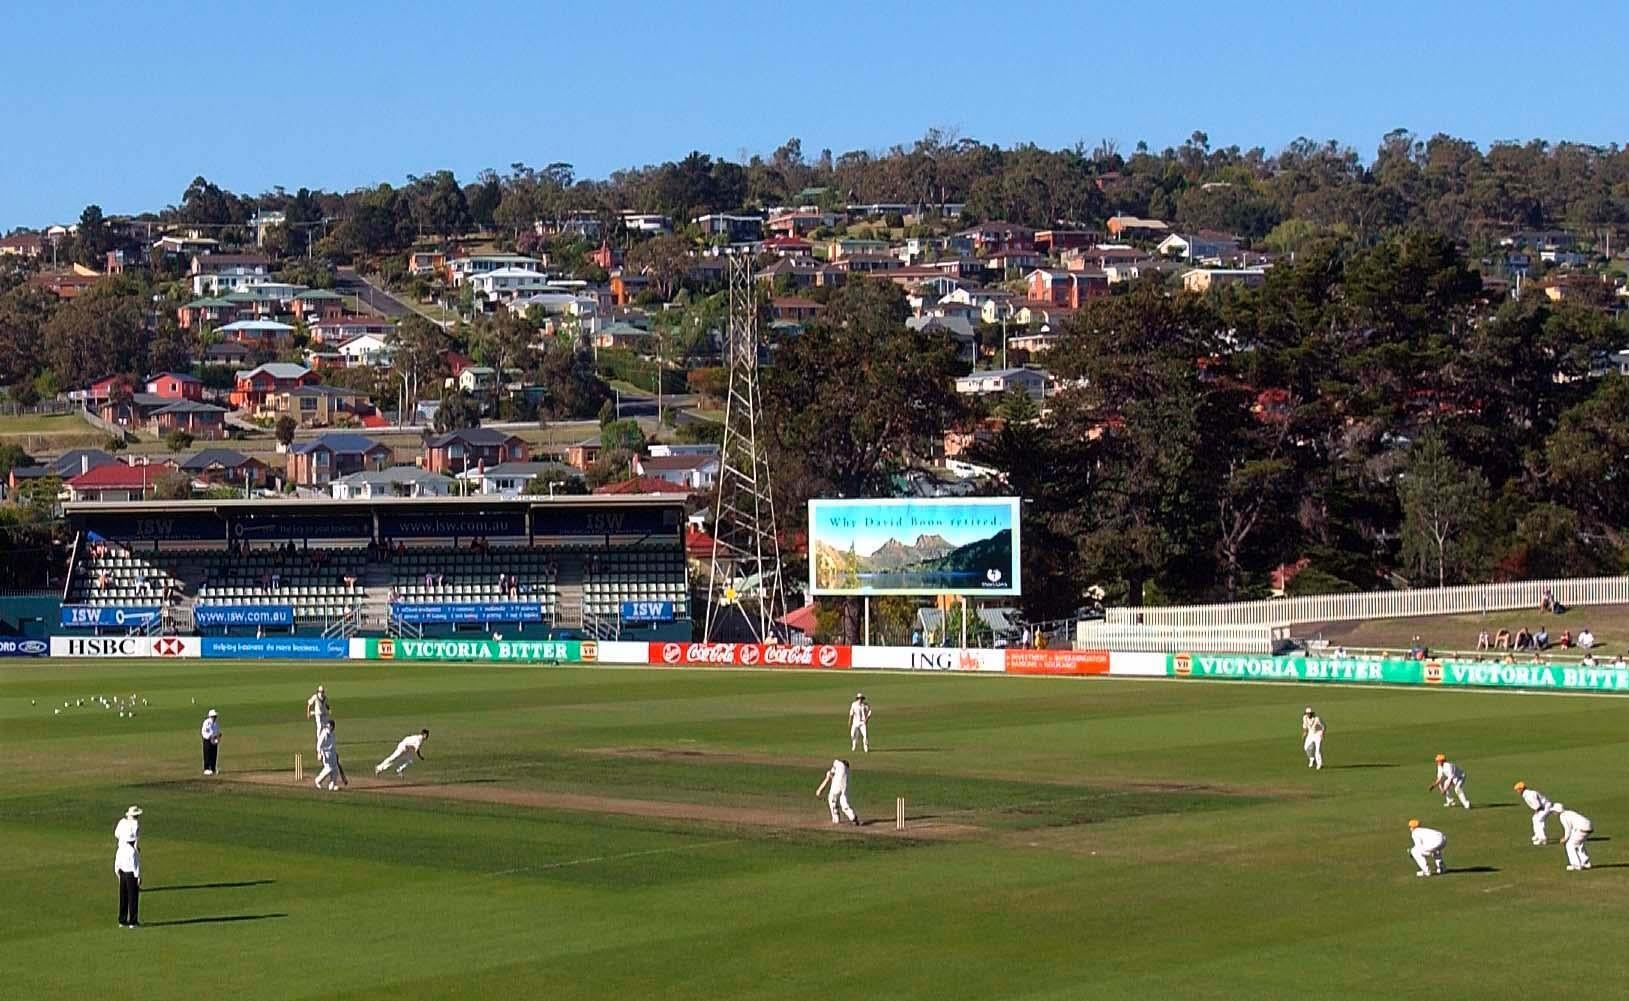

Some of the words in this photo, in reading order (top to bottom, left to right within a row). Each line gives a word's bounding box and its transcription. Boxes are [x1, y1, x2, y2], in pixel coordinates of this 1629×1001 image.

[137, 519, 175, 535] ISW
[585, 513, 625, 529] ISW
[830, 517, 856, 528] Why
[865, 517, 902, 527] David
[72, 609, 101, 622] ISW
[197, 610, 286, 622] www.isw.com.au
[633, 603, 664, 616] ISW
[69, 639, 135, 656] HSBC
[402, 643, 493, 658] VICTORIA
[501, 644, 568, 659] BITTER
[912, 652, 951, 669] ING
[1200, 656, 1298, 677] VICTORIA
[1304, 659, 1383, 679] BITTER
[1453, 665, 1556, 685] VICTORIA
